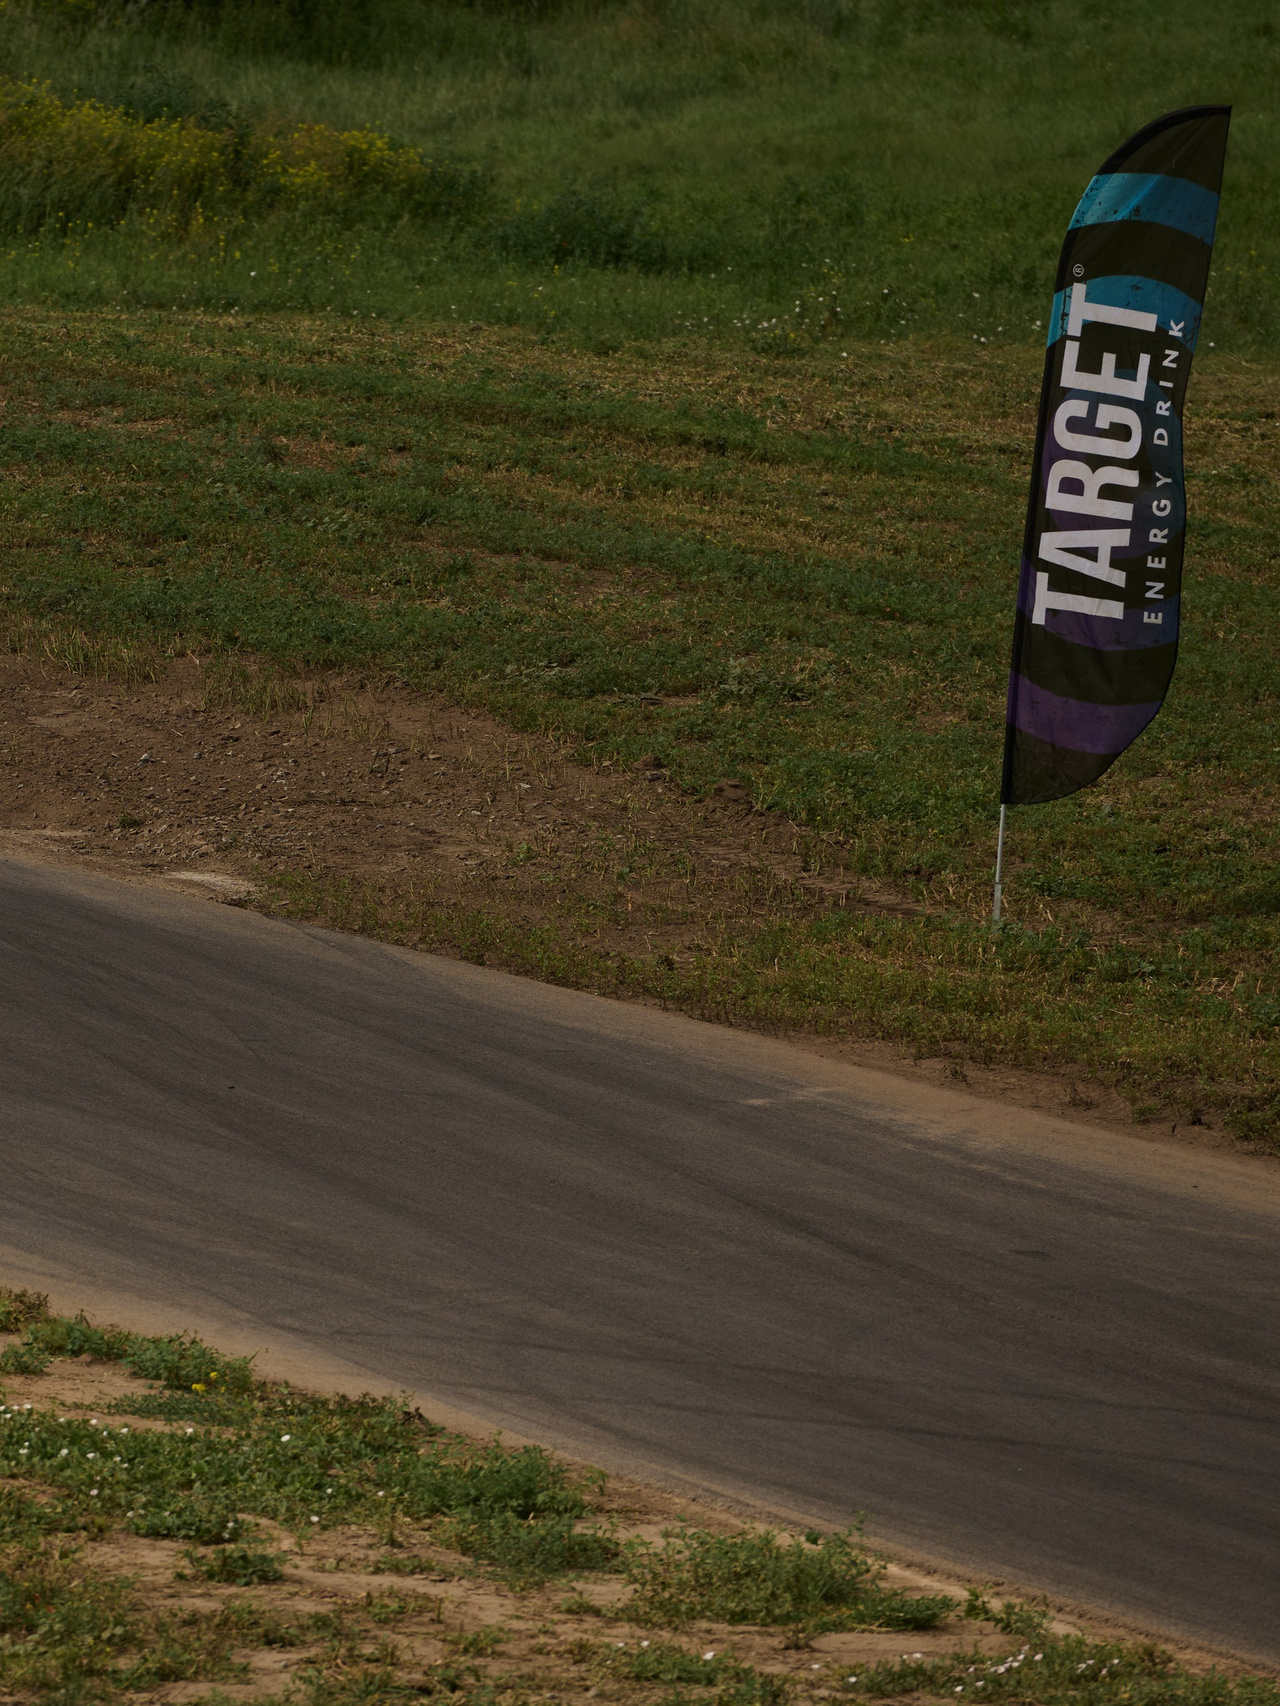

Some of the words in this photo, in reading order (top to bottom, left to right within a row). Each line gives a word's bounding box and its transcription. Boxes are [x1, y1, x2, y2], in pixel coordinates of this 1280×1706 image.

[1032, 282, 1158, 626] TARGET
[1153, 319, 1185, 447] DRINK
[1143, 471, 1173, 625] ENERGY
